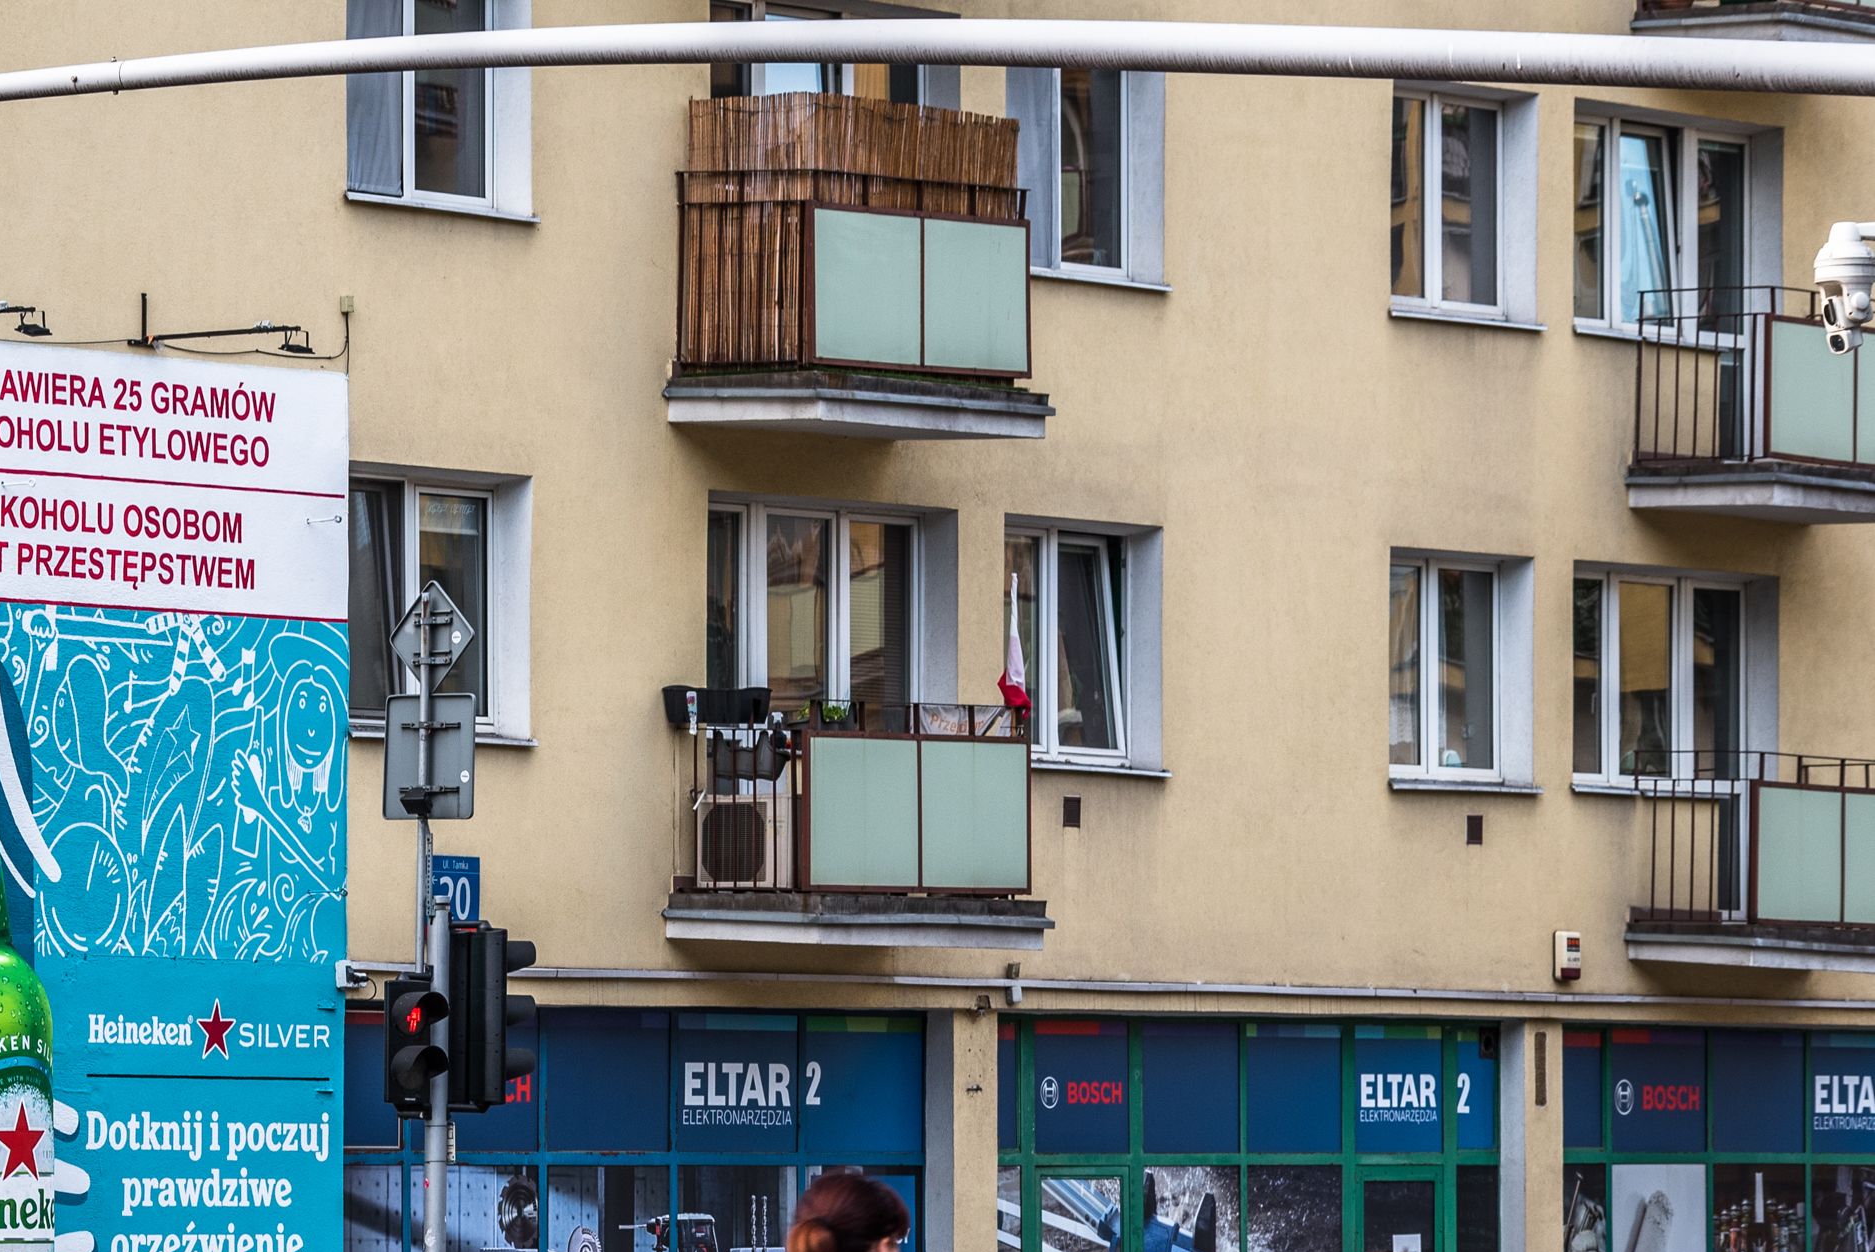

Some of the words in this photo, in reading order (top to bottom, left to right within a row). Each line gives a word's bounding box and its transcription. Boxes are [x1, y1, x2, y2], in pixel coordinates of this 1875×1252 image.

[113, 378, 142, 412] 25
[151, 382, 276, 423] GRAMÓW
[99, 423, 270, 468] ETYLOWEGO
[123, 504, 242, 544] OSOBOM
[17, 542, 255, 590] PRZESTĘPSTWEM
[87, 1014, 193, 1047] Heineken
[239, 1022, 331, 1049] SILVER
[684, 1061, 791, 1107] ELTAR
[805, 1061, 822, 1105] 2
[1067, 1081, 1123, 1105] BOSCH
[1360, 1073, 1437, 1108] ELTAR
[1456, 1072, 1471, 1114] 2
[1642, 1084, 1701, 1111] BOSCH
[85, 1110, 203, 1161] Dotknij
[210, 1110, 220, 1151] i
[226, 1112, 330, 1162] poczuj
[682, 1108, 793, 1129] ELEKTRONARZĘDZIA
[1359, 1109, 1438, 1125] ELEKTRONARZĘDZIA
[121, 1167, 293, 1217] prawdziwe
